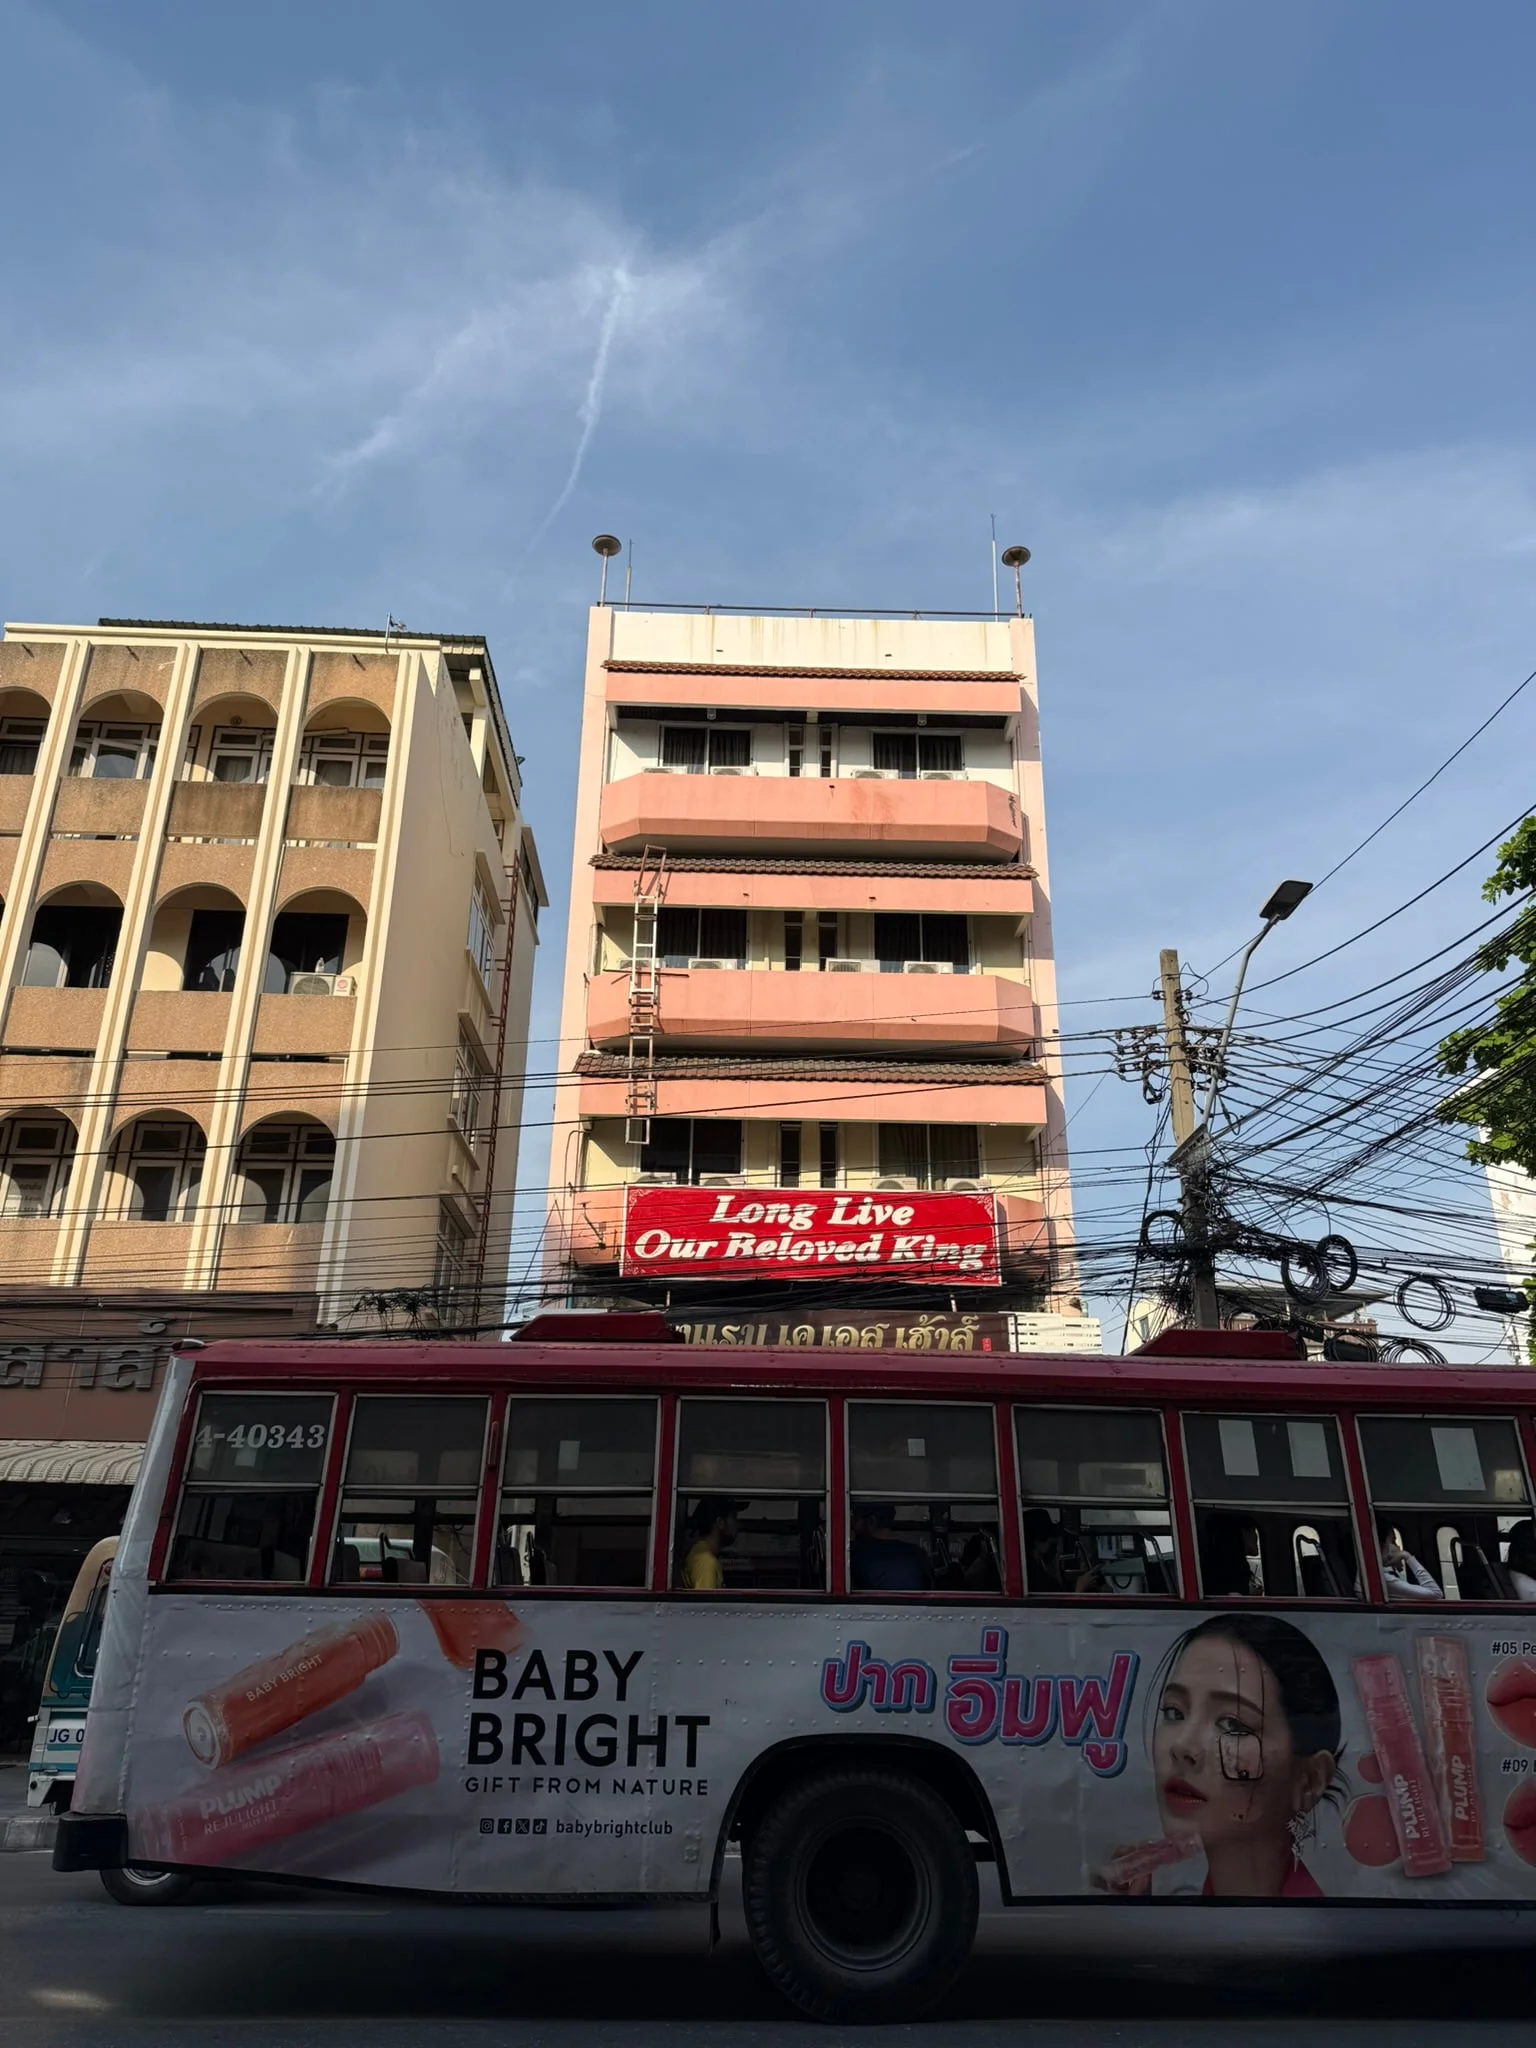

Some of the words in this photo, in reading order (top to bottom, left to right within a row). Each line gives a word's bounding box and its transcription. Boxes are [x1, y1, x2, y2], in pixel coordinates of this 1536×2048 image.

[709, 1194, 818, 1231] Long
[827, 1196, 915, 1227] Live
[633, 1228, 718, 1259] Our
[721, 1231, 883, 1263] Beloved
[887, 1233, 988, 1271] King
[822, 1323, 891, 1348] เอส
[894, 1313, 980, 1352] เฮ้าส์
[195, 1422, 326, 1450] 4-40343
[1491, 1641, 1517, 1655] #05
[246, 1676, 280, 1702] BABY
[279, 1653, 324, 1684] BRIGHT
[472, 1647, 645, 1702] BABY
[820, 1639, 938, 1714] ปาก
[943, 1625, 1141, 1779] อิ่มฟู
[50, 1728, 70, 1743] JG
[467, 1711, 711, 1768] BRIGHT
[465, 1776, 521, 1793] GIFT
[533, 1777, 601, 1795] FROM
[612, 1778, 709, 1796] NATURE
[1502, 1759, 1529, 1773] #09
[199, 1775, 283, 1820] PLUMP
[1393, 1773, 1421, 1839] PLUMP
[1451, 1754, 1470, 1820] PLUMP
[555, 1819, 674, 1838] babybrightclub
